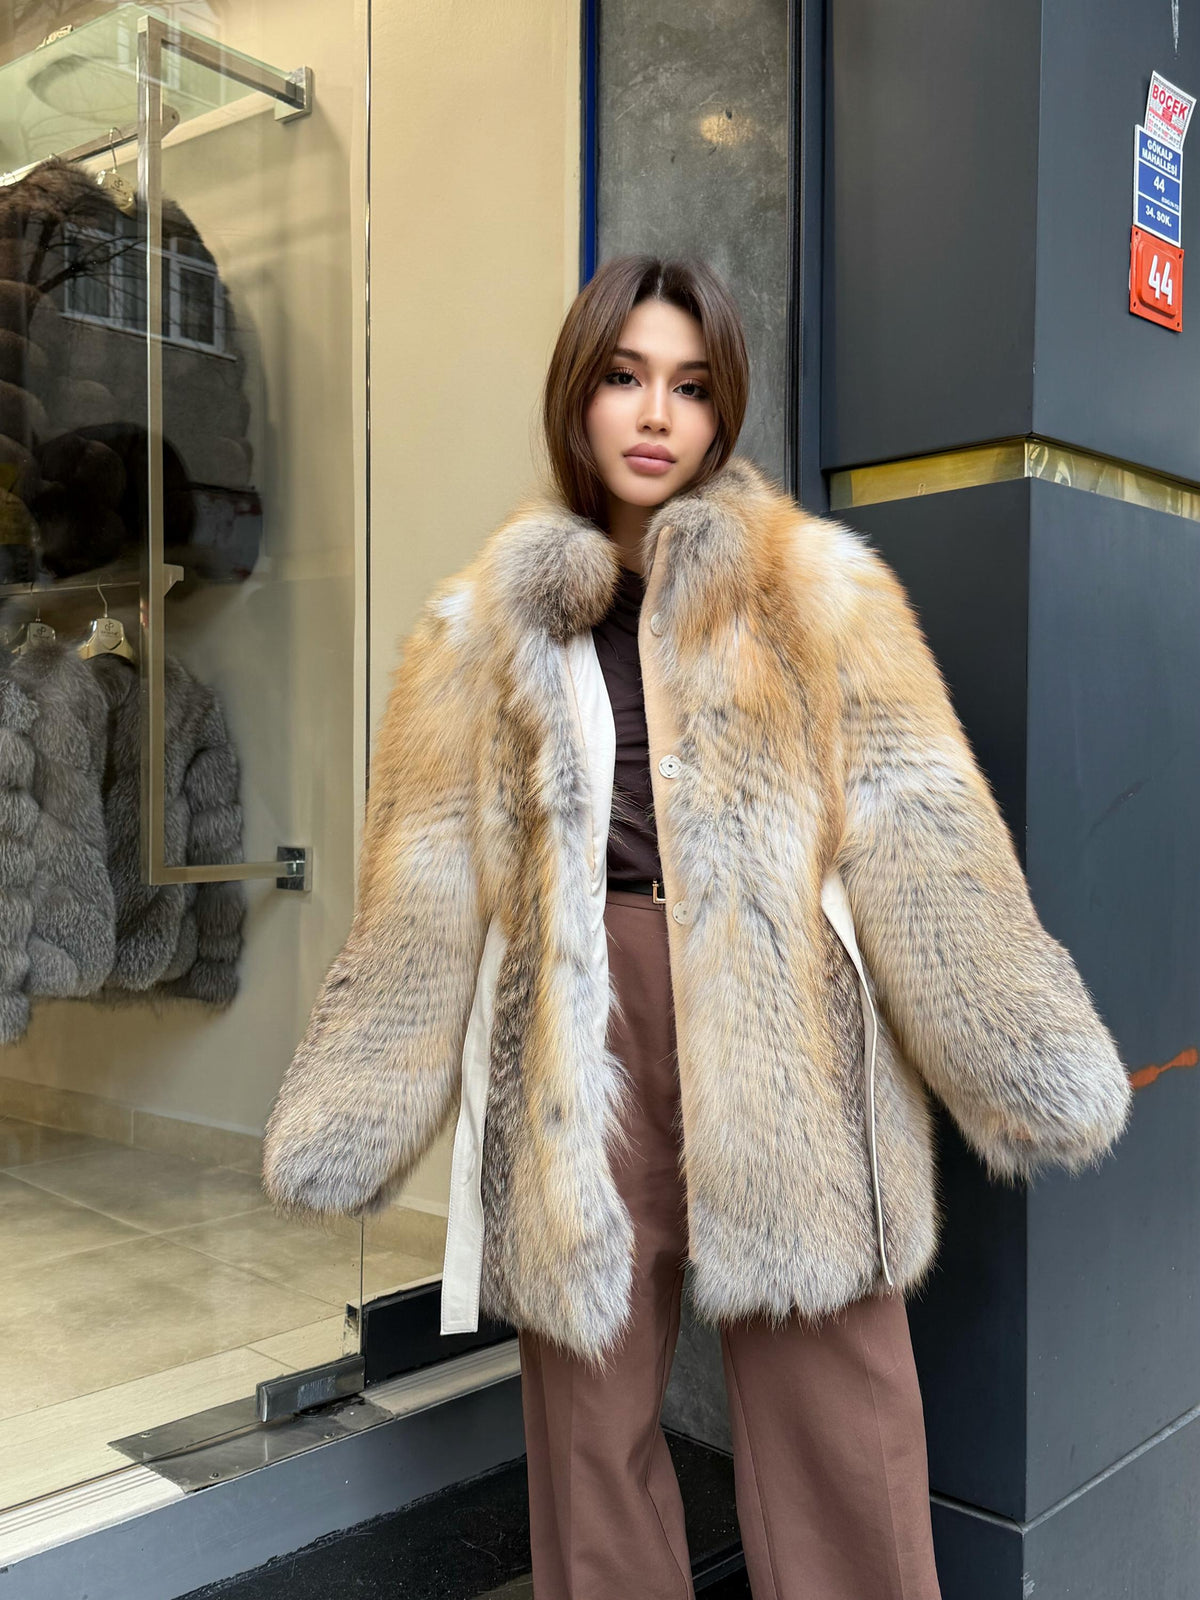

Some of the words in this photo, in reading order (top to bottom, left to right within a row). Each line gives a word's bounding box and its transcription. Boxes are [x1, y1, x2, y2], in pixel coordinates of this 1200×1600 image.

[1147, 139, 1173, 161] GÖKALP
[1141, 147, 1178, 177] MAHALLESİ
[1153, 175, 1166, 193] 44
[1156, 210, 1172, 227] SOK.
[1148, 254, 1173, 306] 44
